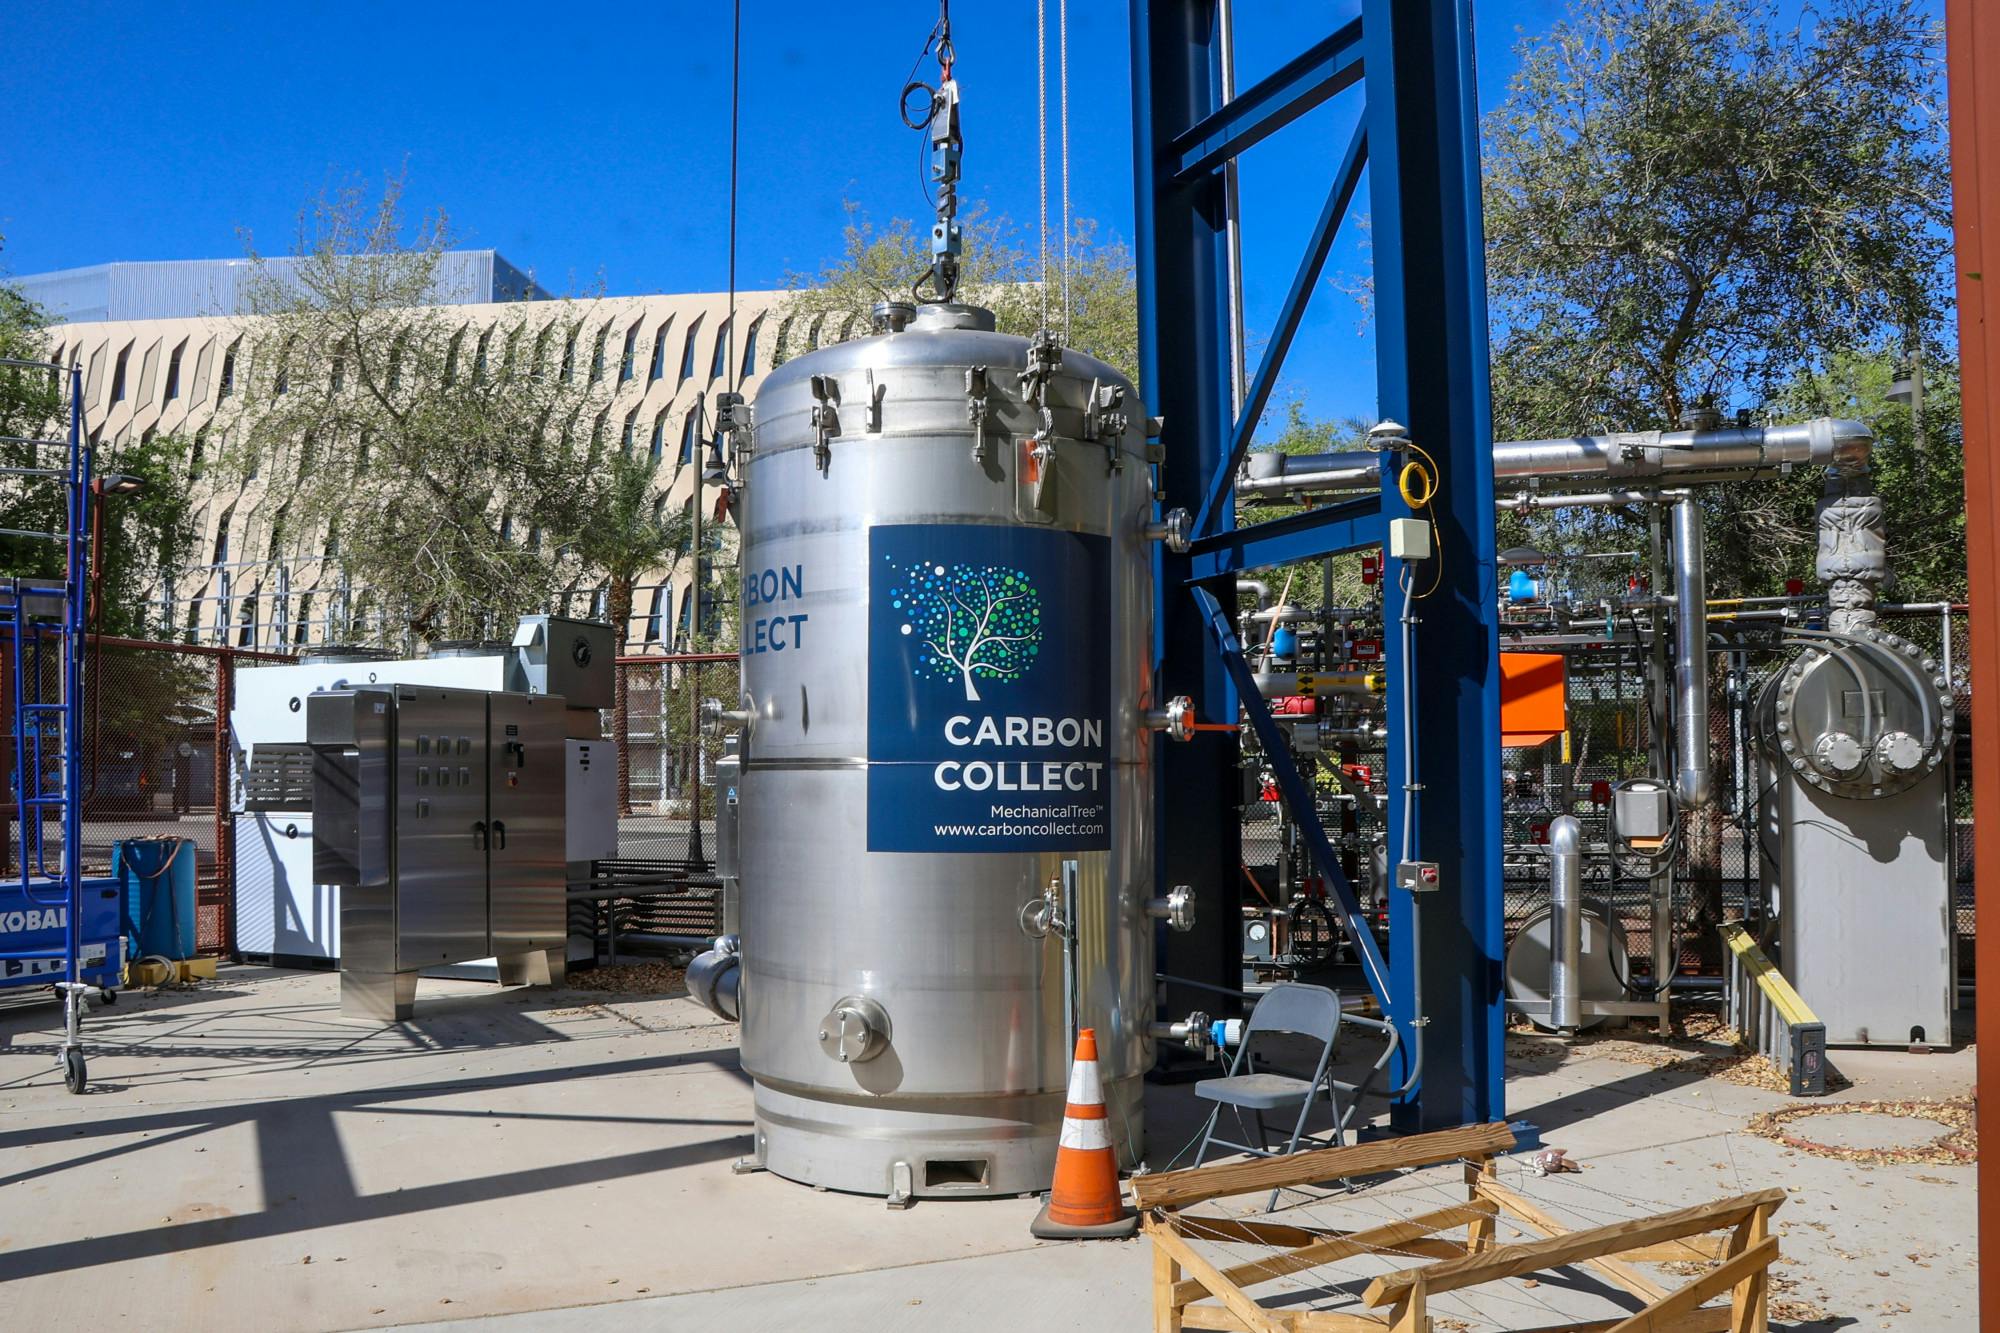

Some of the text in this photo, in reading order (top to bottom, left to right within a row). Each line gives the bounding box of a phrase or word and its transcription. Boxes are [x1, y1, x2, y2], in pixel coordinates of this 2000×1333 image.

[741, 614, 808, 656] LECT
[944, 715, 1102, 747] CARBON
[934, 760, 1103, 791] COLLECT
[934, 822, 1104, 836] www.carboncollect.com
